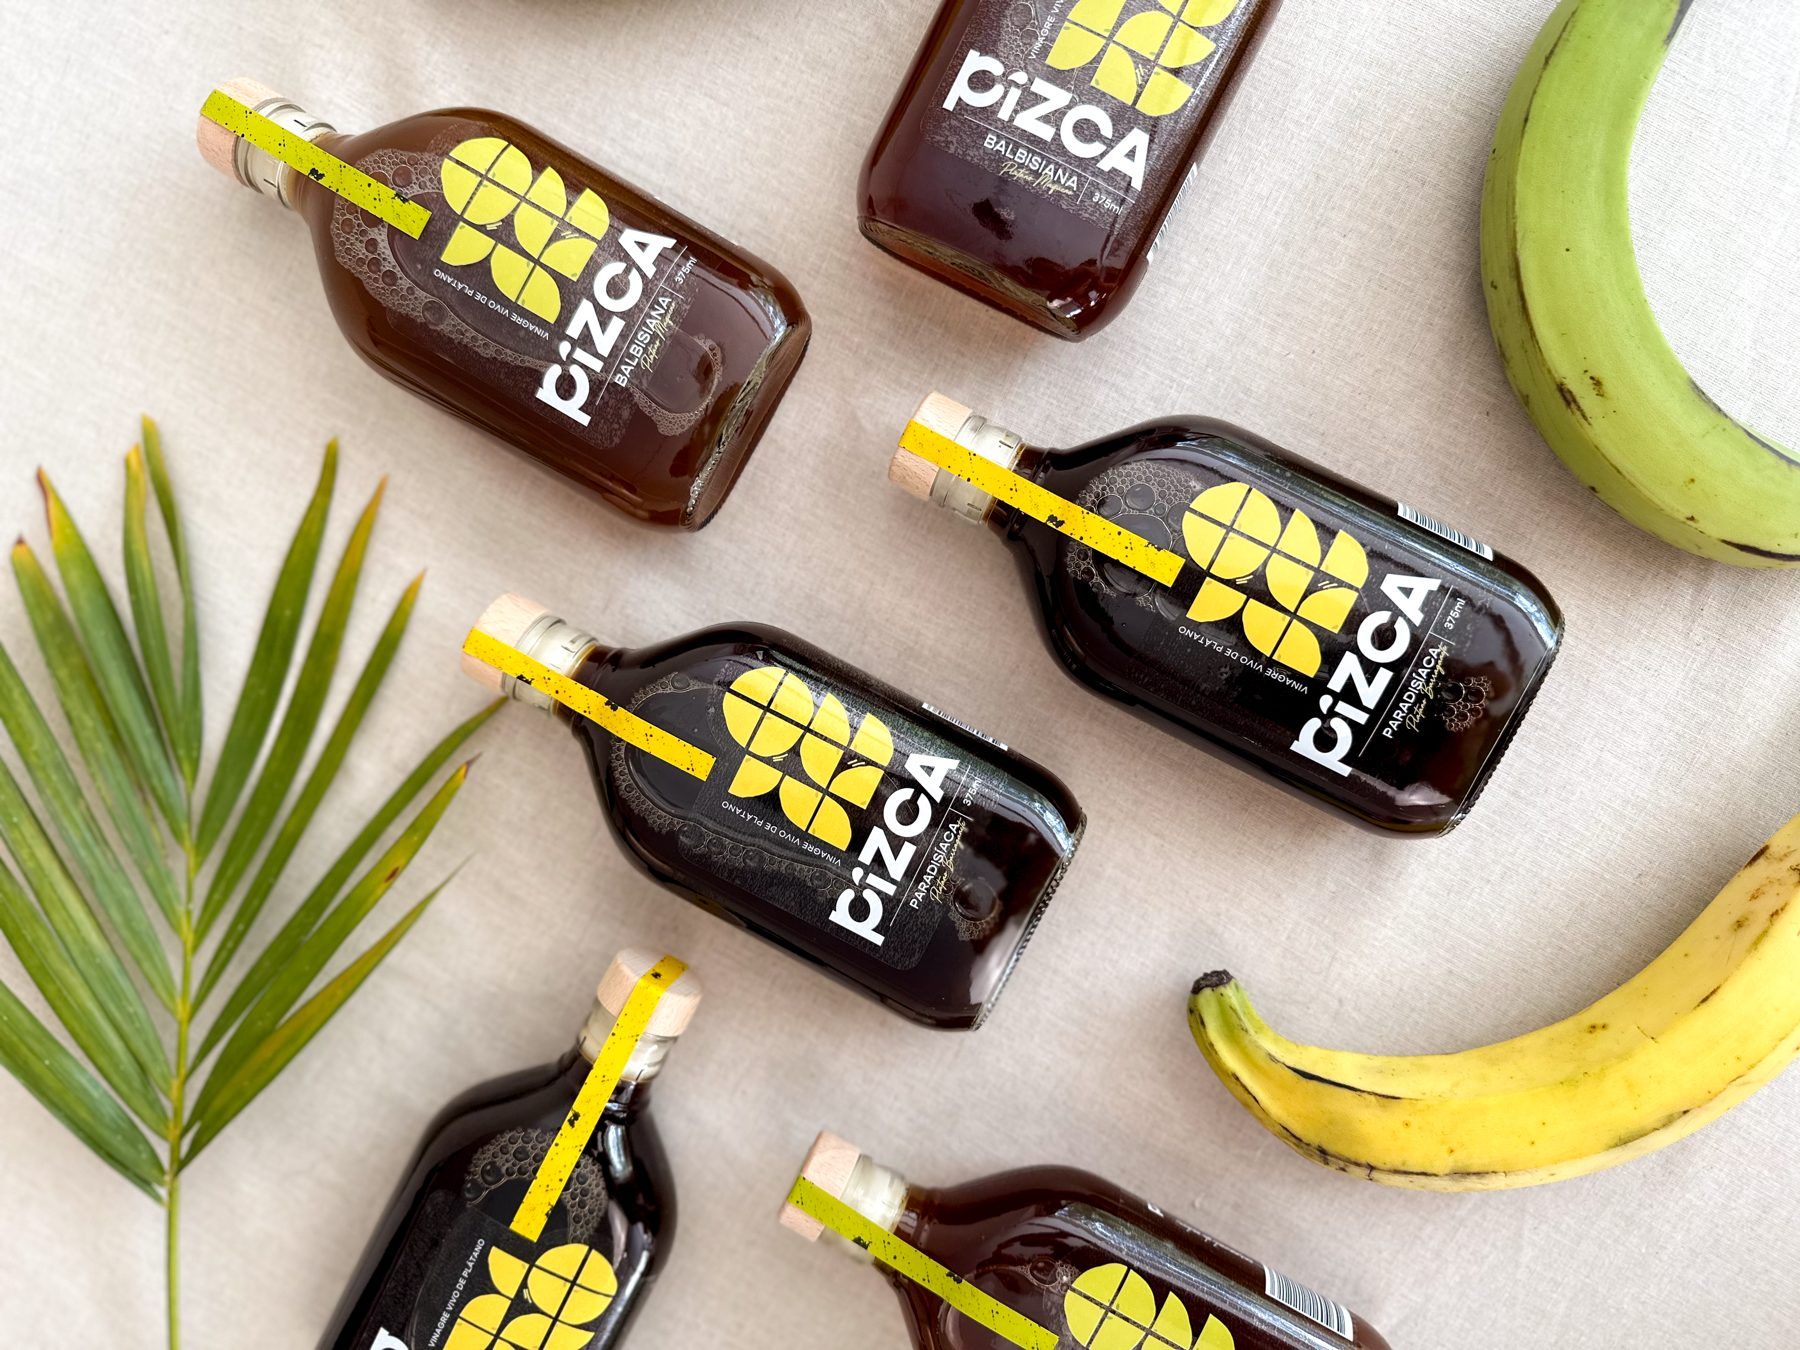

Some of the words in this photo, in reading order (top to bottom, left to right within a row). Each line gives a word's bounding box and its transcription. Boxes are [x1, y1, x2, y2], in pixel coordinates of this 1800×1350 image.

[1028, 15, 1056, 59] VINAGRE
[983, 133, 1078, 191] BALBISIANA
[1092, 192, 1124, 215] 375ml
[433, 268, 473, 297] PLÁTANO
[474, 291, 488, 304] DE
[487, 301, 509, 317] VIVO
[509, 314, 549, 340] VINAGRE
[614, 296, 672, 387] BALBISIANA
[674, 256, 698, 285] 375ml
[1178, 625, 1224, 653] PLÁTANO
[1224, 647, 1239, 660] DE
[1239, 655, 1263, 673] VIVO
[1264, 667, 1308, 695] VINAGRE
[1382, 647, 1440, 739] PARADISÍACA
[1444, 598, 1466, 630] 375ml
[721, 800, 764, 827] PLÁTANO
[764, 822, 778, 834] DE
[778, 829, 801, 846] VIVO
[801, 841, 841, 867] VINAGRE
[909, 822, 960, 910] PARADISÍACA
[962, 777, 983, 807] 375ml
[428, 1310, 450, 1347] VINAGRE
[445, 1290, 460, 1311] VIVO
[456, 1277, 467, 1291] DE
[462, 1238, 485, 1279] PLÁTANO
